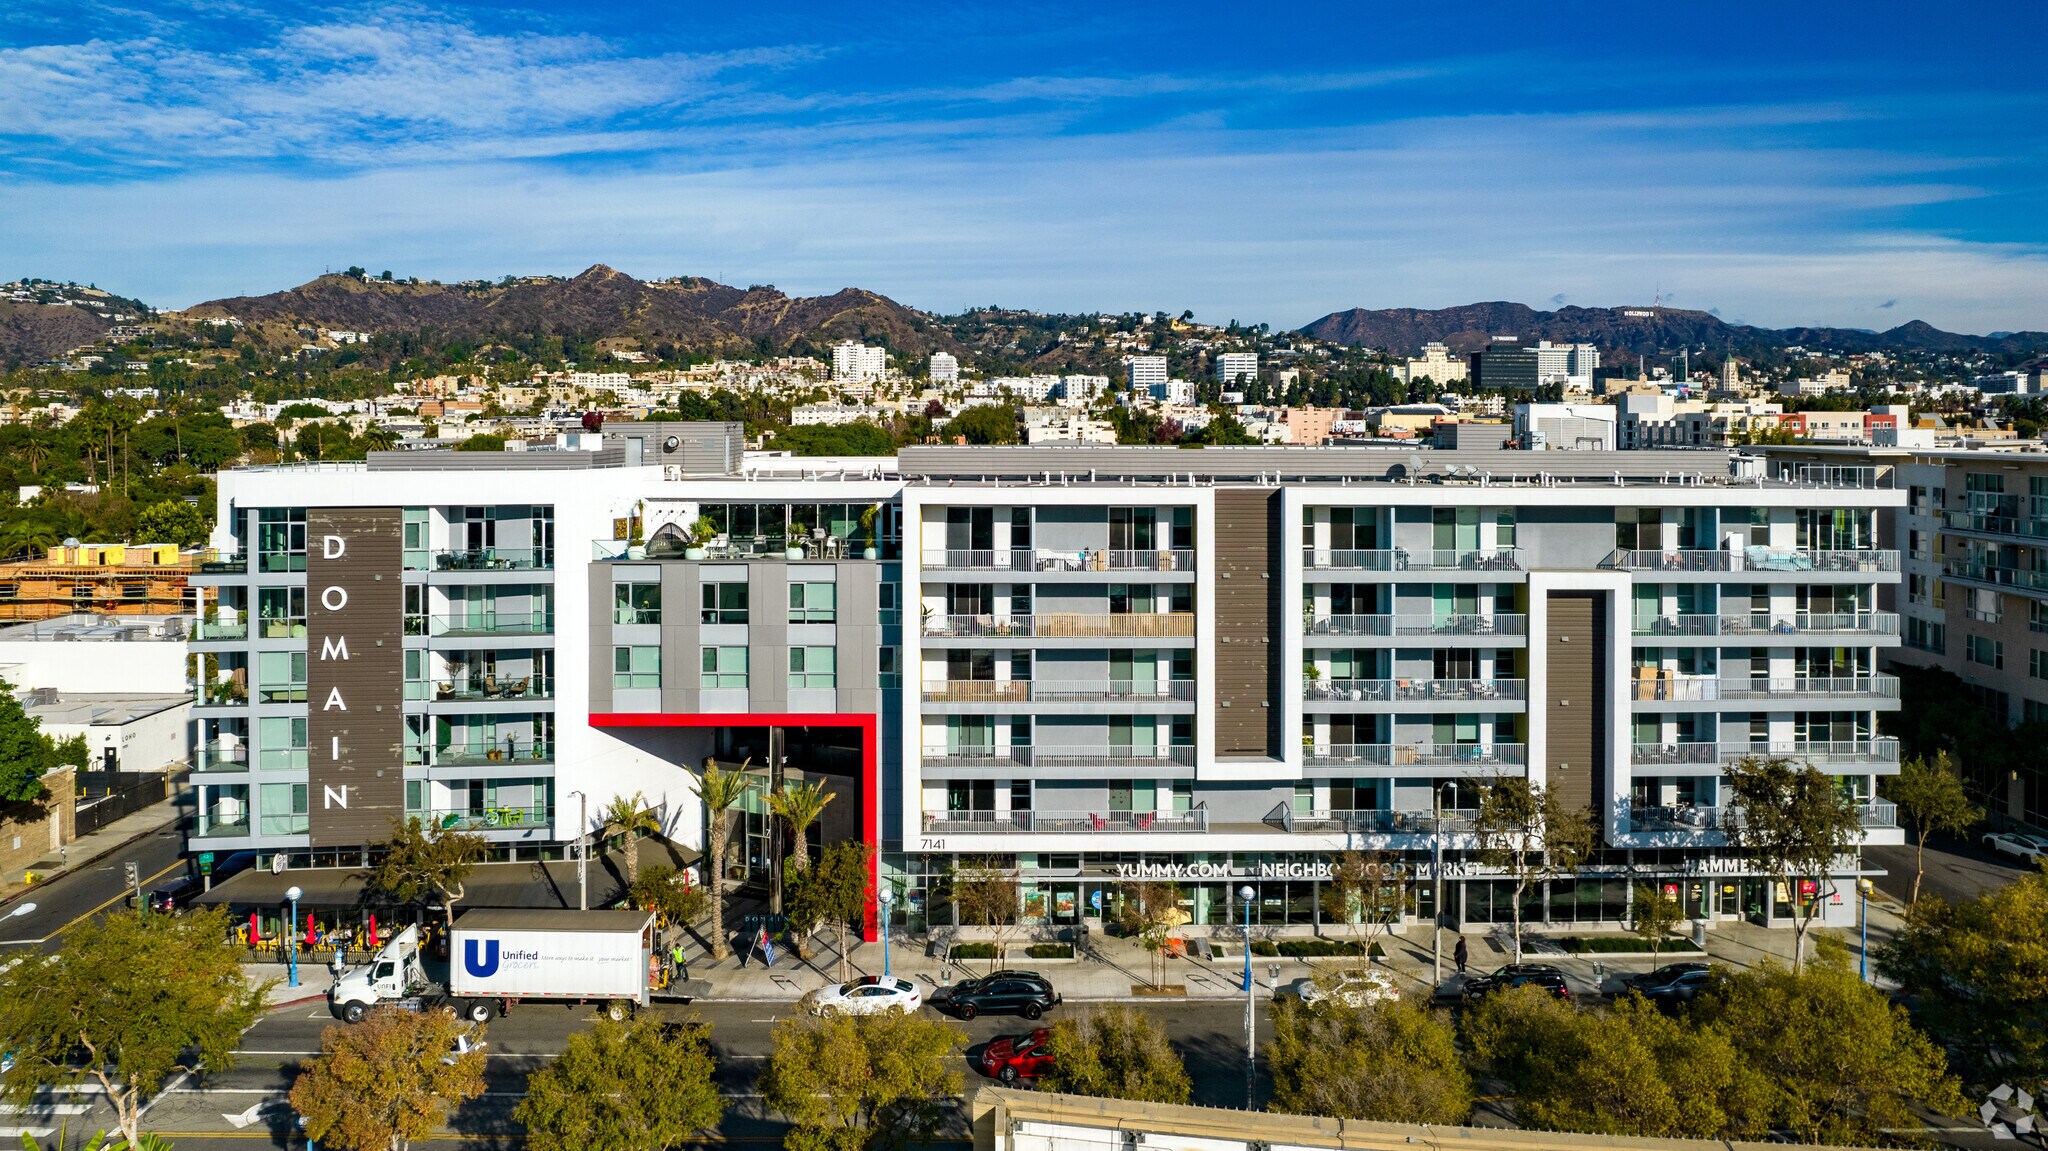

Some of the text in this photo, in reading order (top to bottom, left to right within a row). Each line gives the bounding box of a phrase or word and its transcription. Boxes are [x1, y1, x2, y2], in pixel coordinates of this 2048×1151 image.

[320, 535, 349, 810] DOMAIN
[920, 839, 945, 849] 7141
[1116, 862, 1483, 877] YUMMY.COM NEIGHBOOOD MRKET
[464, 939, 499, 978] U
[502, 950, 538, 960] Unified
